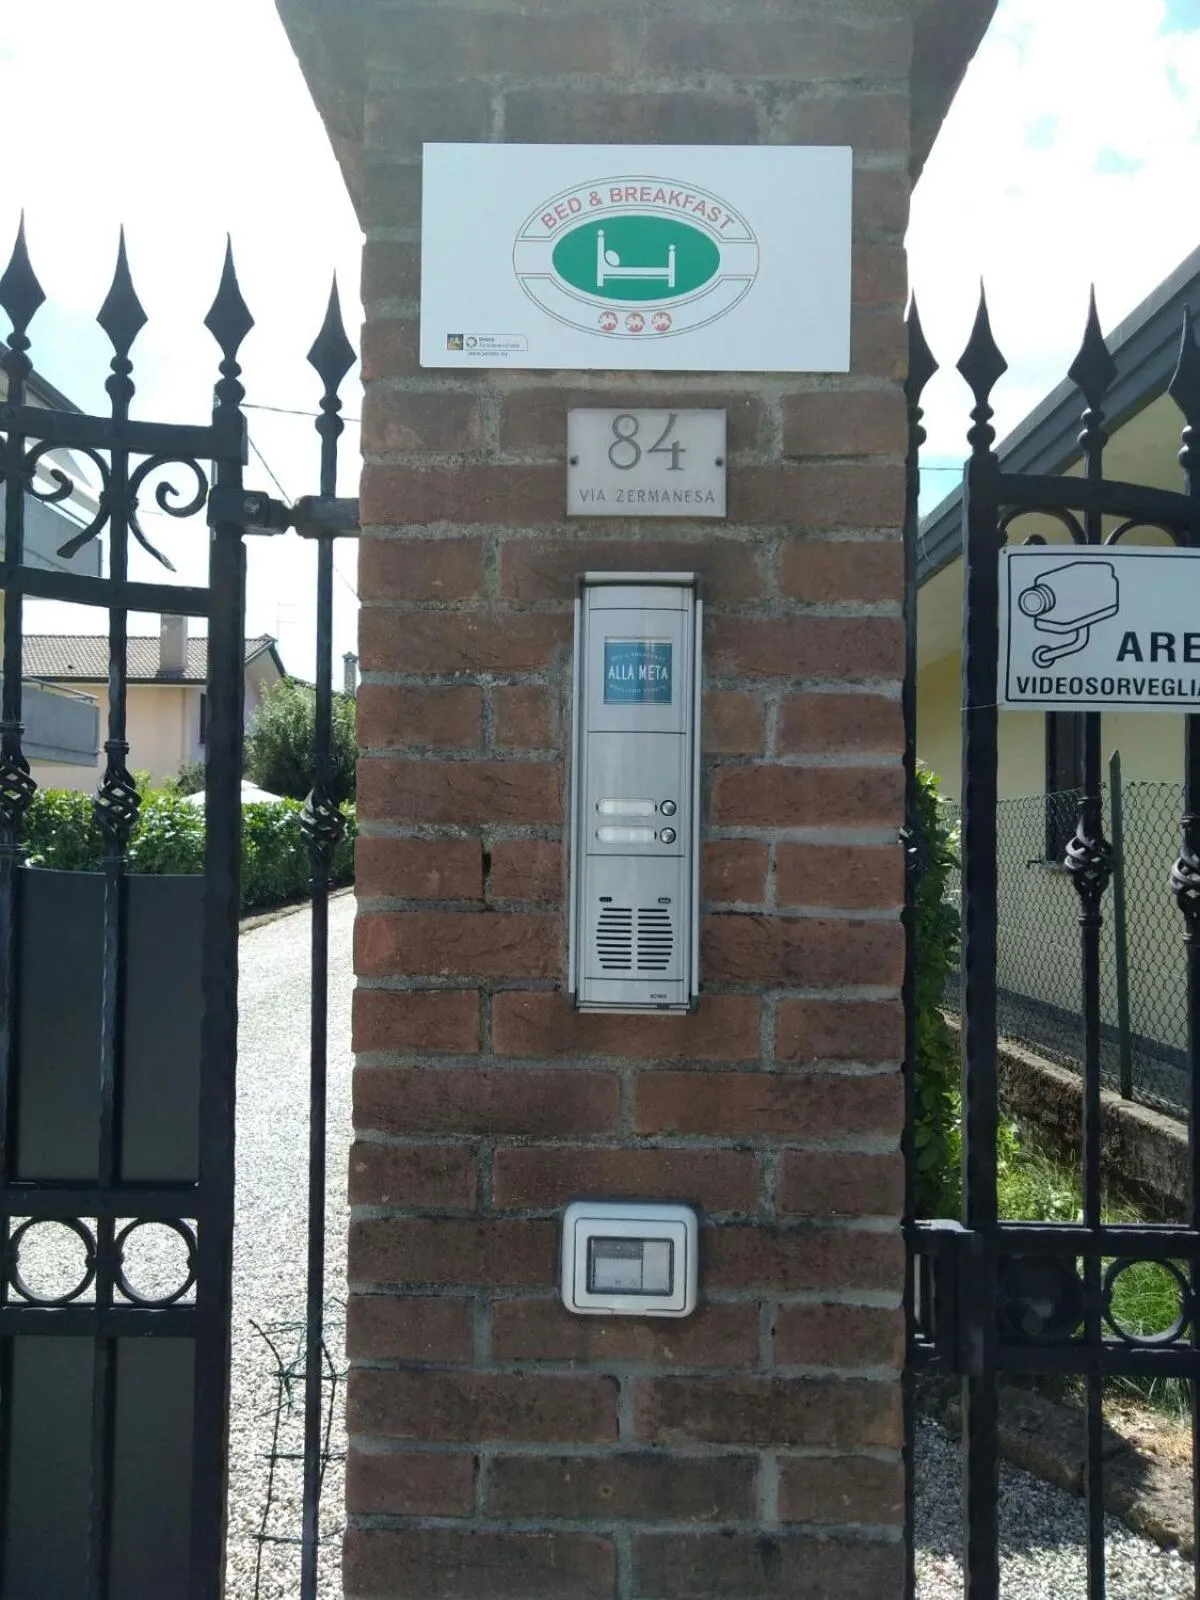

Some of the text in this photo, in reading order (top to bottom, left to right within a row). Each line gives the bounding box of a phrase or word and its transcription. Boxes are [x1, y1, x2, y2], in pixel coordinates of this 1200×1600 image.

[541, 186, 735, 230] BED & BREAKFAST
[607, 413, 686, 471] 84
[579, 489, 715, 504] VIA ZERMANESA
[1116, 631, 1200, 663] ARE
[608, 664, 669, 681] ALLA META
[1017, 676, 1200, 697] VIDEOSORVEGLI
